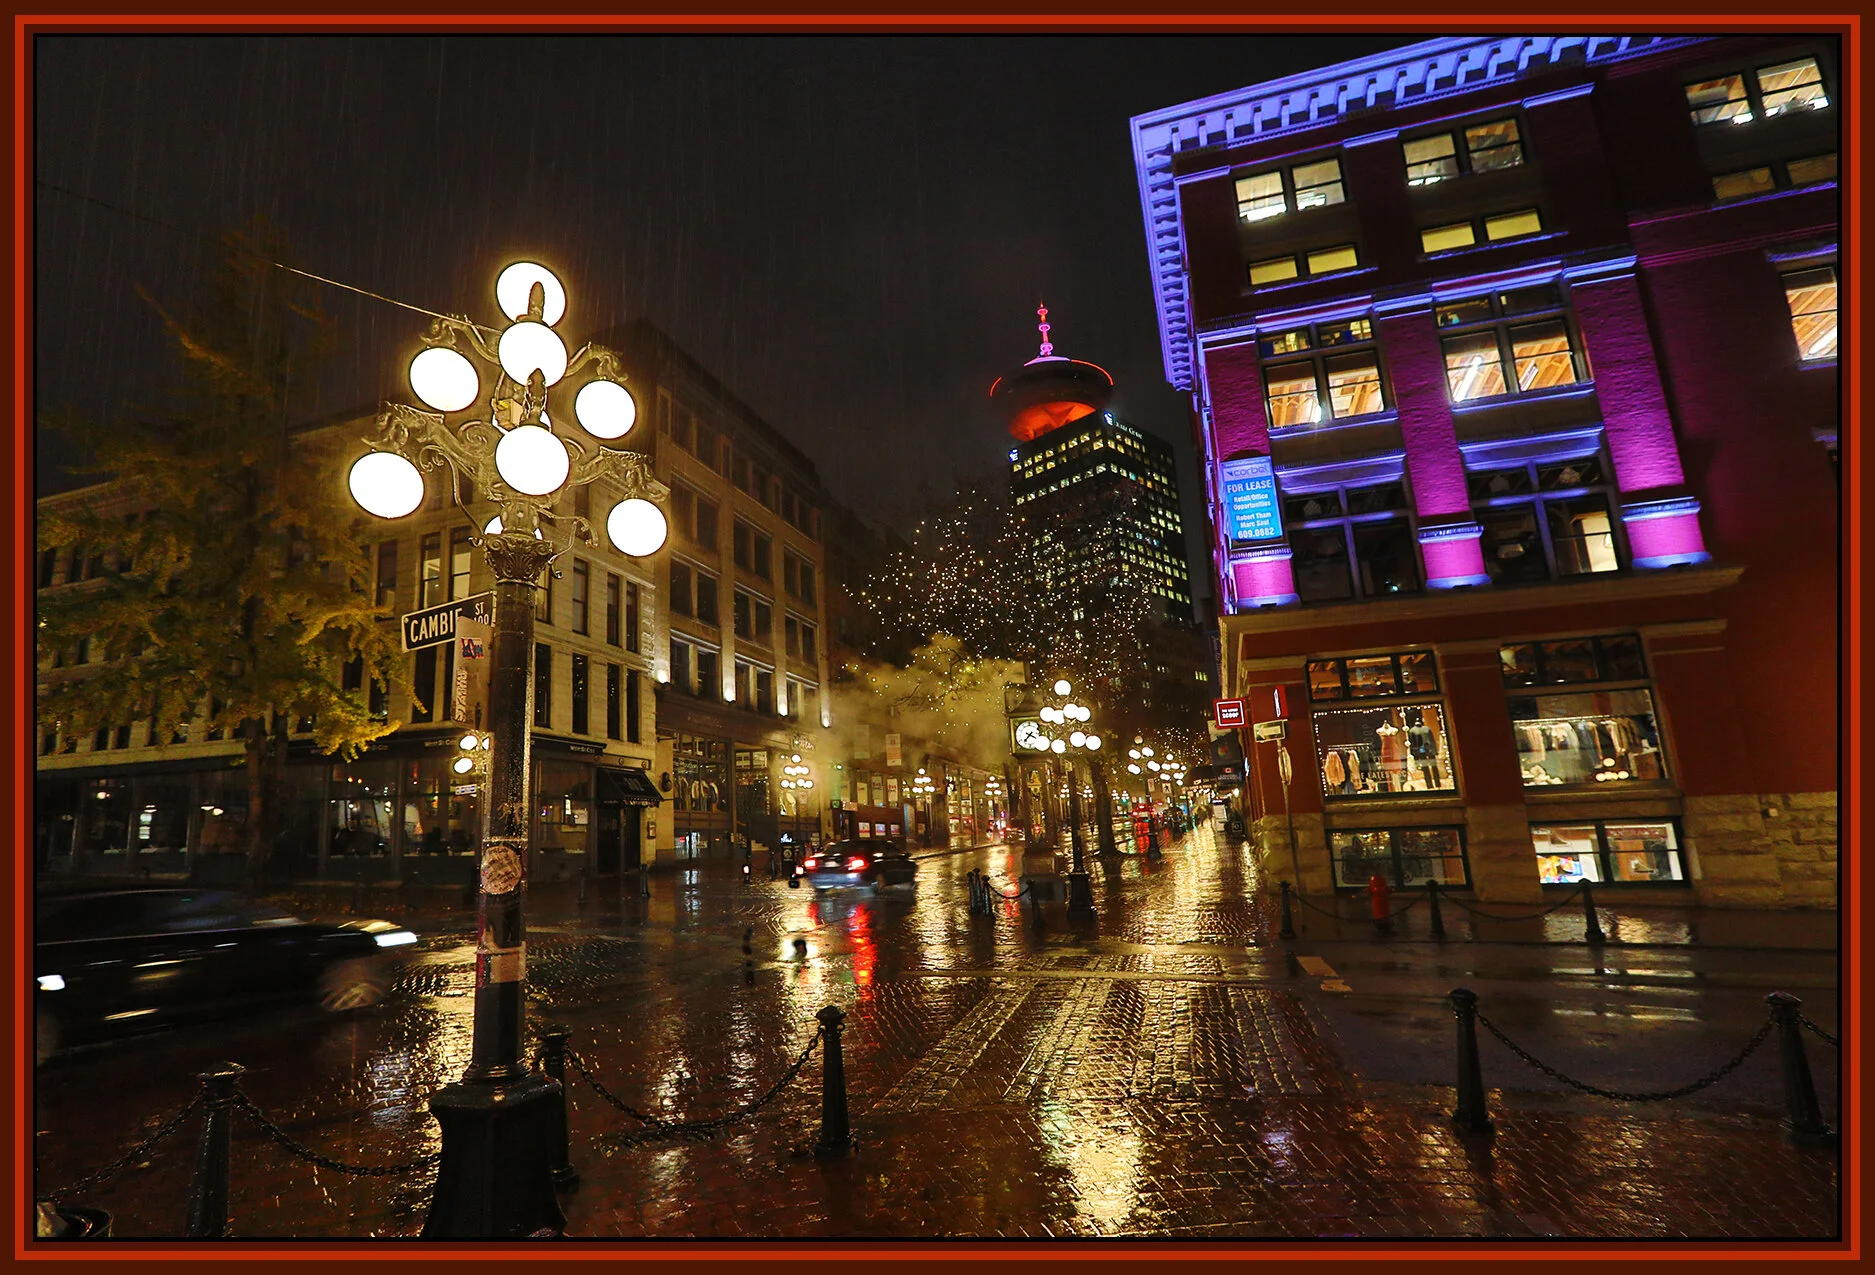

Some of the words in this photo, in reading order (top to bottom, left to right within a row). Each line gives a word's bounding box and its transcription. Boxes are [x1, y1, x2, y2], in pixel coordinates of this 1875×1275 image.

[1233, 465, 1266, 476] corbel
[1227, 484, 1243, 493] FOR
[1246, 480, 1272, 490] LEASE
[1233, 501, 1271, 510] Opportunities
[1238, 527, 1274, 538] 609.0882
[474, 601, 484, 616] ST
